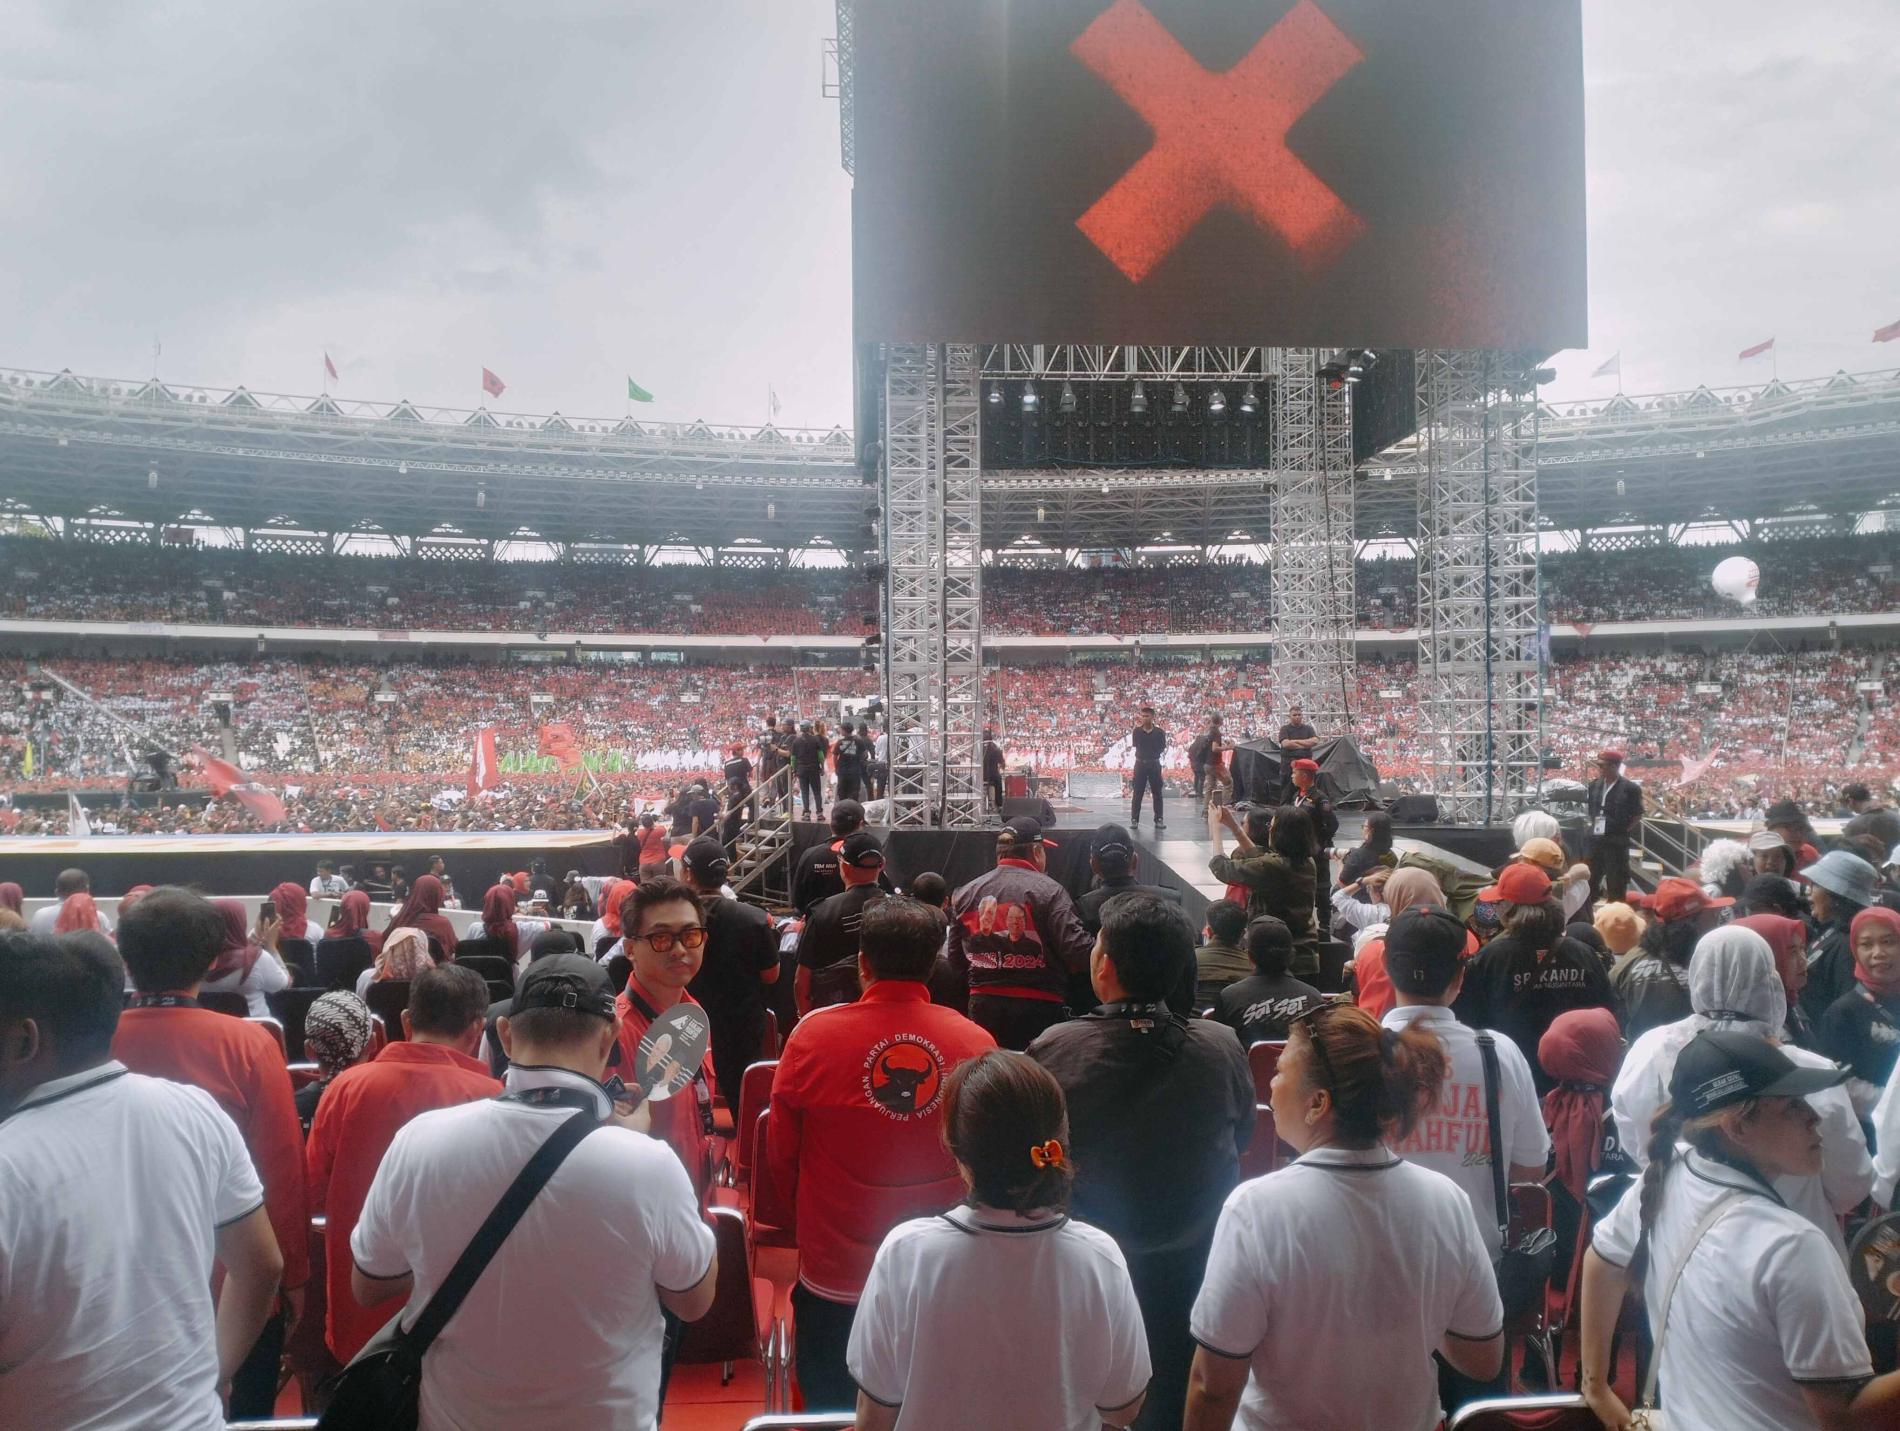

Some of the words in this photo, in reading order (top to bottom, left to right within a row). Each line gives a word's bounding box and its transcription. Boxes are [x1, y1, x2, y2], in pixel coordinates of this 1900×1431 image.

[1002, 954, 1046, 968] 2024
[863, 1038, 889, 1069] PARTAI
[894, 1033, 946, 1066] DEMOKRASI
[862, 1075, 910, 1121] PERJUANGAN
